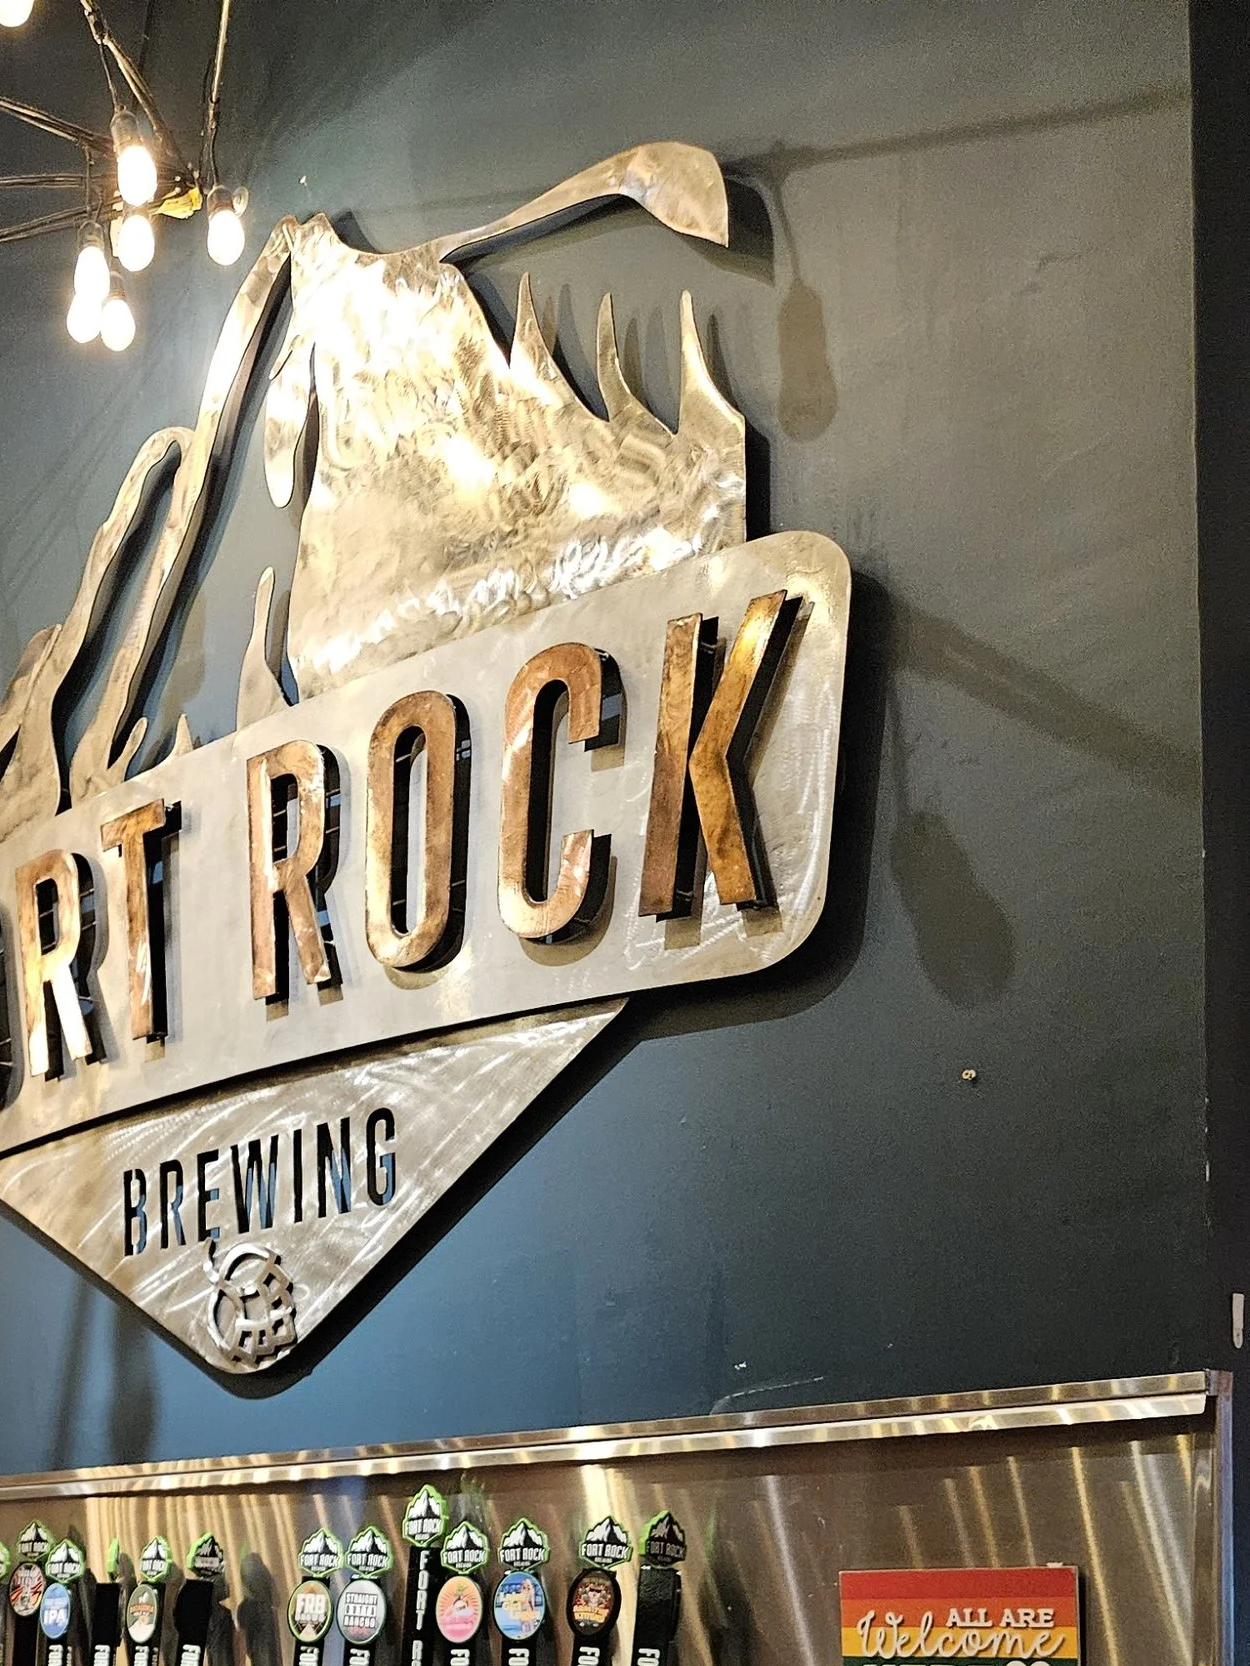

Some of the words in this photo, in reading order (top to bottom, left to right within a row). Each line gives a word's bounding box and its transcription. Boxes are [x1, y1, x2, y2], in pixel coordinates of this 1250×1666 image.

[245, 590, 798, 1002] ROCK
[124, 1107, 399, 1256] BREWING
[444, 1550, 464, 1564] FORT
[464, 1550, 486, 1563] ROCK
[500, 1548, 522, 1562] FORT
[522, 1548, 545, 1562] ROCK
[582, 1544, 604, 1558] FORT
[605, 1544, 629, 1559] ROCK
[347, 1553, 367, 1567] FORT
[367, 1554, 389, 1568] ROCK
[415, 1550, 430, 1631] FORT
[346, 1592, 378, 1605] STRAIGHT
[43, 1609, 66, 1625] IPA
[344, 1616, 376, 1628] RANCHO
[946, 1608, 993, 1628] ALL
[1000, 1608, 1055, 1628] ARE
[857, 1610, 1065, 1660] Welcome
